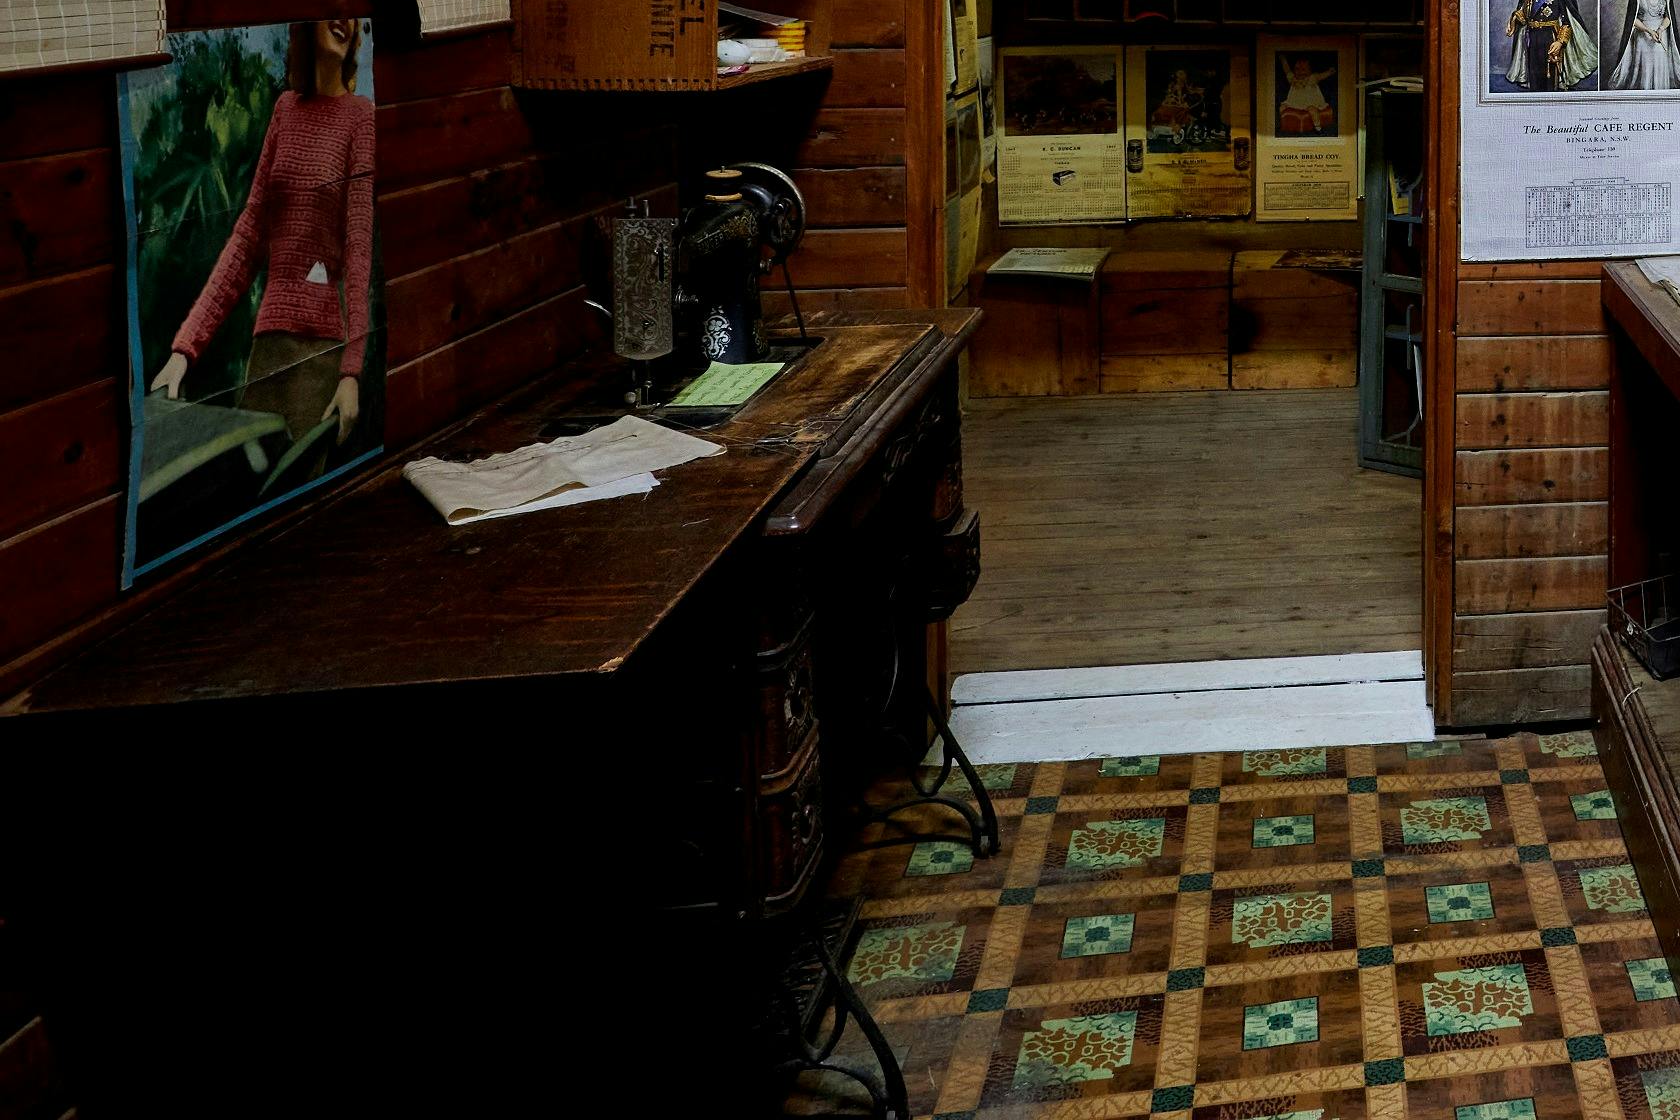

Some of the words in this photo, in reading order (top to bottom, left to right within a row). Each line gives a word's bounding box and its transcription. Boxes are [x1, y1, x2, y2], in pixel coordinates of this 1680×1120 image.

[1524, 125, 1541, 134] The
[1547, 124, 1588, 135] Beautiful
[1594, 124, 1623, 132] CAFE
[1628, 122, 1673, 131] REGENT
